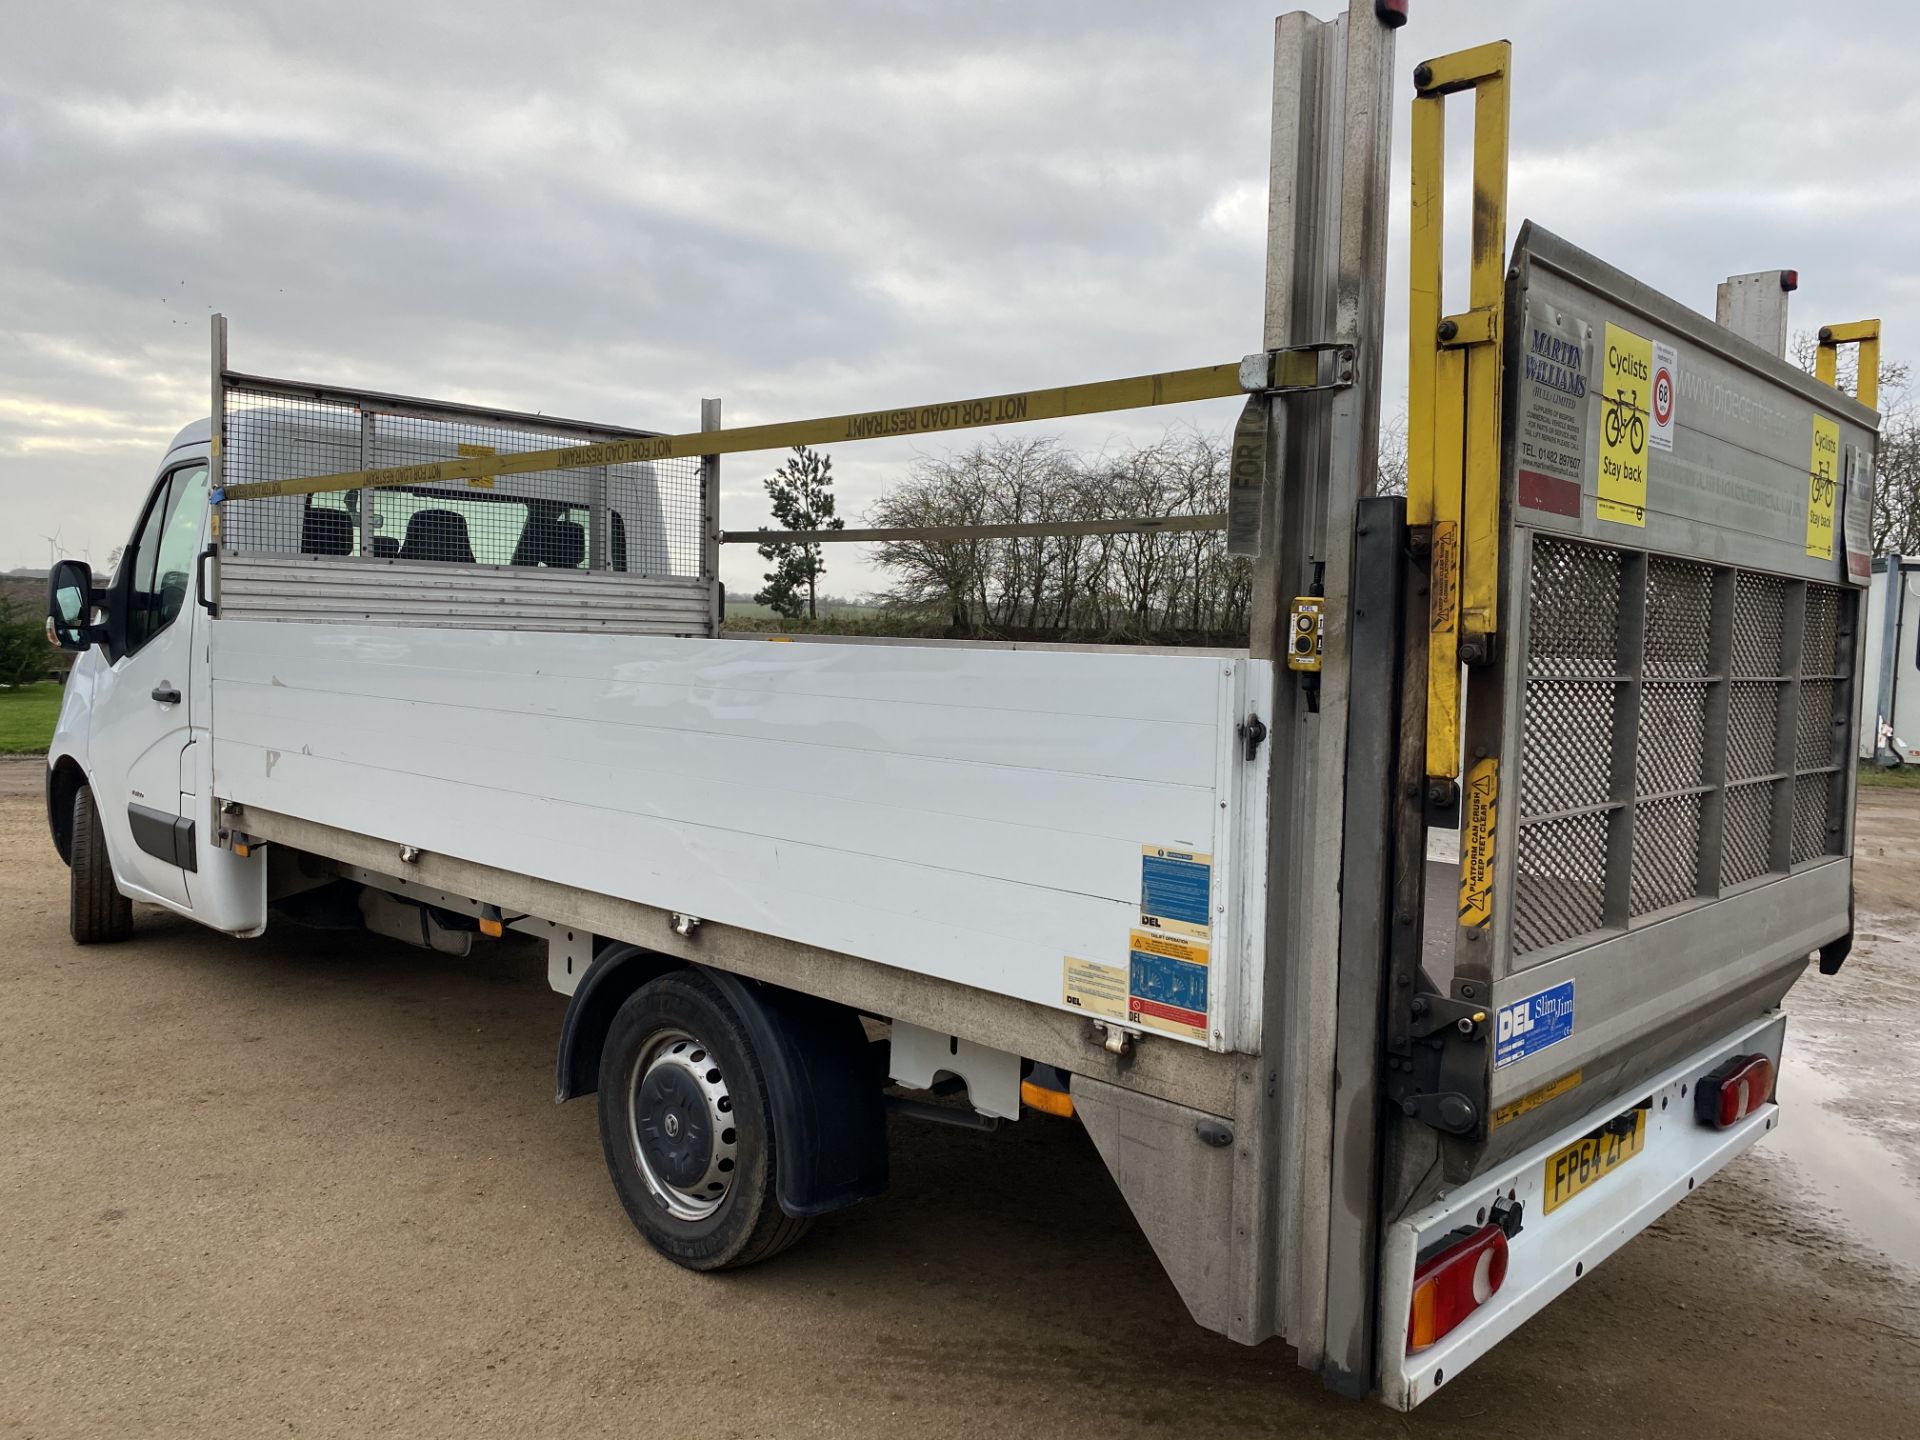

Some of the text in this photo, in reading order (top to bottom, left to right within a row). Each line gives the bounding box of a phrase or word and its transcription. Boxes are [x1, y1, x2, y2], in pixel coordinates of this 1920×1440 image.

[1531, 329, 1582, 371] MARTIN
[1608, 345, 1648, 381] Cyclists
[1526, 355, 1588, 398] WILLIAMS
[1552, 394, 1576, 409] LIMITED
[1658, 383, 1669, 403] 68
[846, 396, 1027, 437] NOT FOR LOAD RESTRAINT
[557, 440, 672, 466] NOT FOR LOAD RESTRAINT
[1522, 442, 1537, 458] TEL.
[1539, 448, 1557, 463] 01482
[1814, 430, 1836, 453] Cyclists
[396, 468, 412, 482] LOAD
[414, 467, 426, 480] FOR
[428, 465, 441, 479] NOT
[1234, 444, 1263, 488] FOR
[1603, 456, 1642, 483] Stay back
[1810, 510, 1831, 528] Stay back
[1469, 792, 1480, 892] PLATFORM CAN CRUSH
[1477, 804, 1488, 882] KEEP FEET CLEAR
[1141, 916, 1161, 928] DEL
[1066, 996, 1081, 1006] DEL
[1535, 995, 1573, 1019] Slim Jim
[1129, 1011, 1141, 1024] DEL
[1499, 1002, 1535, 1044] DEL
[1554, 1139, 1602, 1202] FP64
